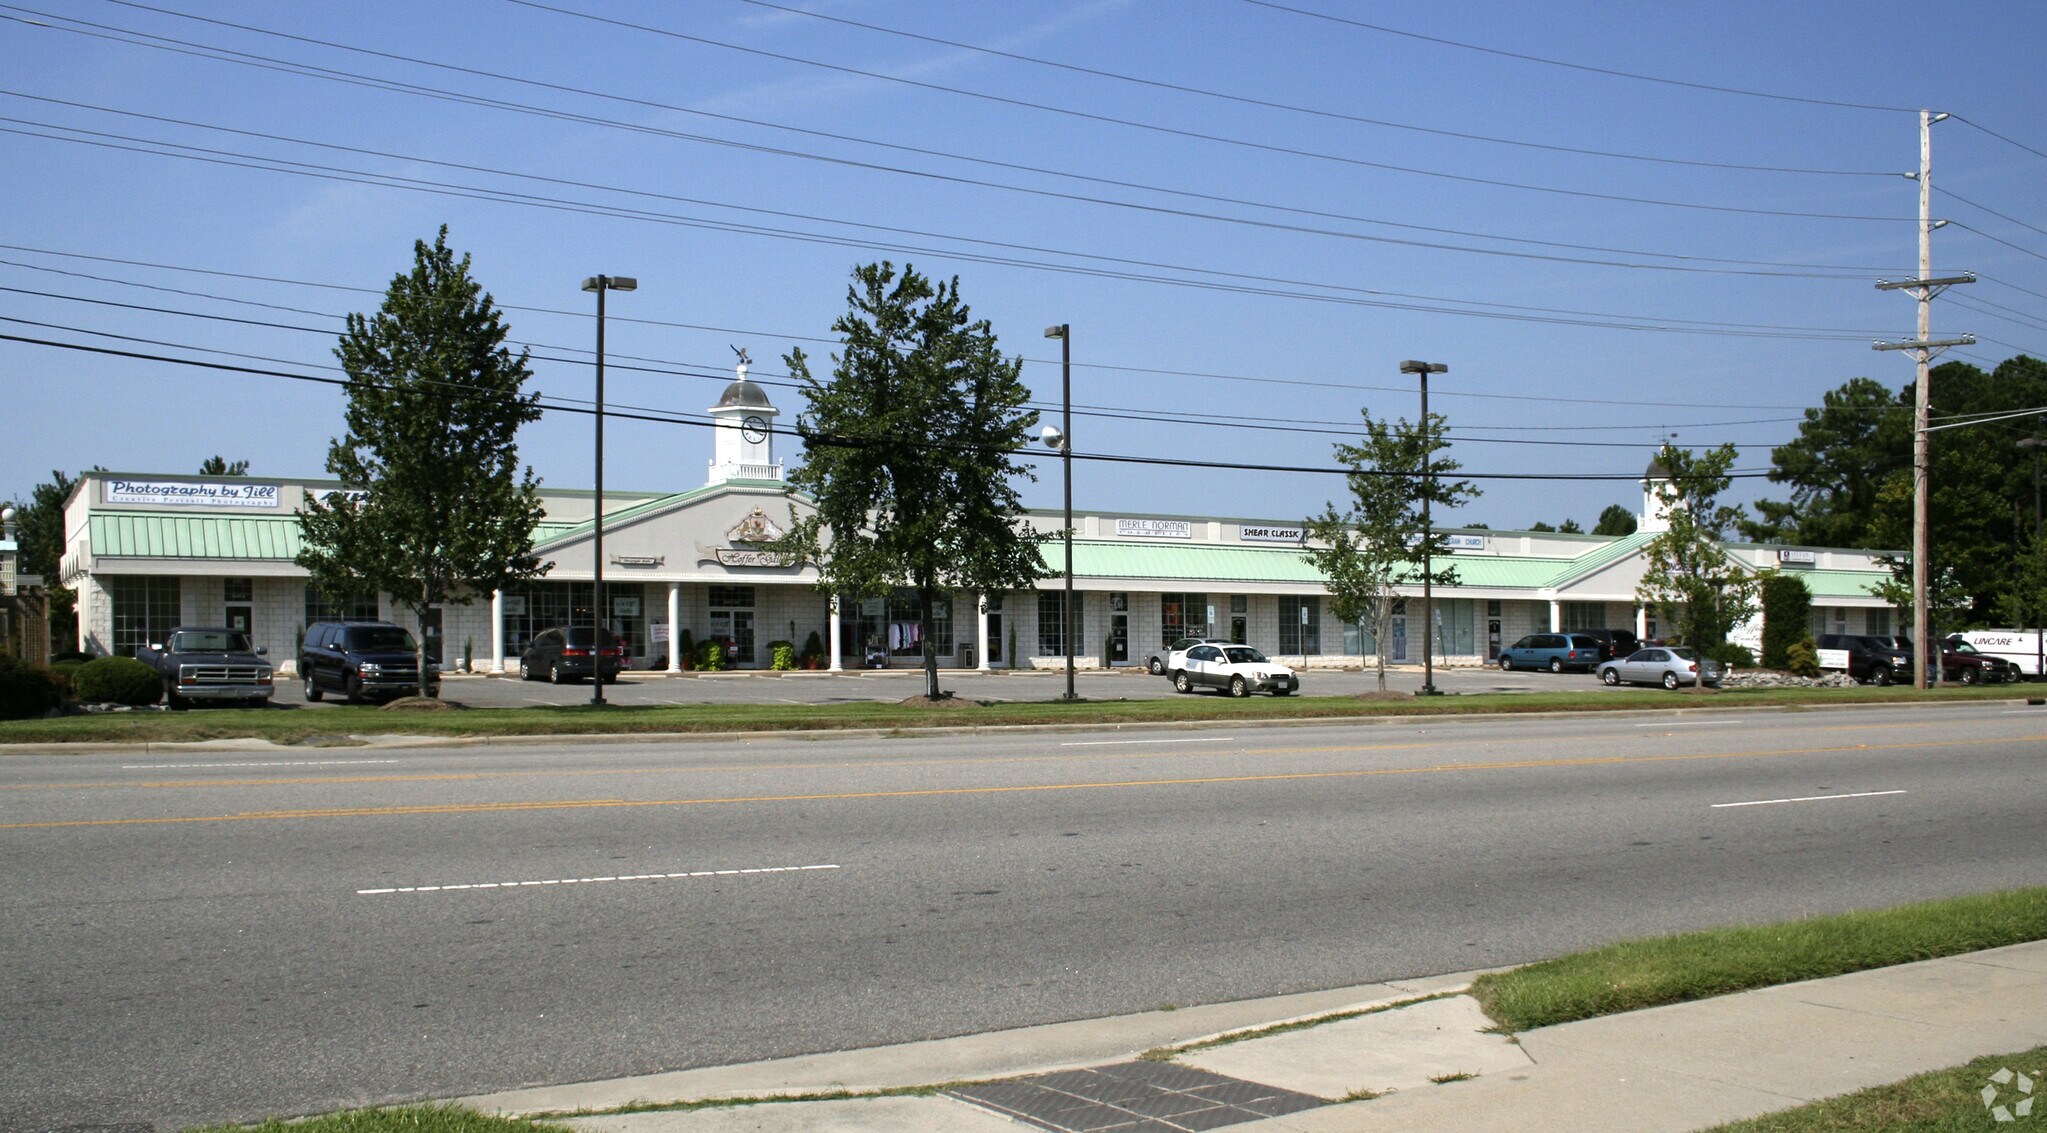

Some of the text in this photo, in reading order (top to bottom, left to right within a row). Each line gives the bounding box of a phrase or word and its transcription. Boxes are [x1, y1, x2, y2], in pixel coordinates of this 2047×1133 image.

[112, 481, 275, 499] Photography by Jill
[112, 495, 157, 503] Creative
[1118, 519, 1189, 531] MERLE NORMAN
[1243, 528, 1300, 538] SHEAR CLASSIC
[721, 552, 756, 566] Hoffer
[1973, 637, 2012, 646] LINCARE
